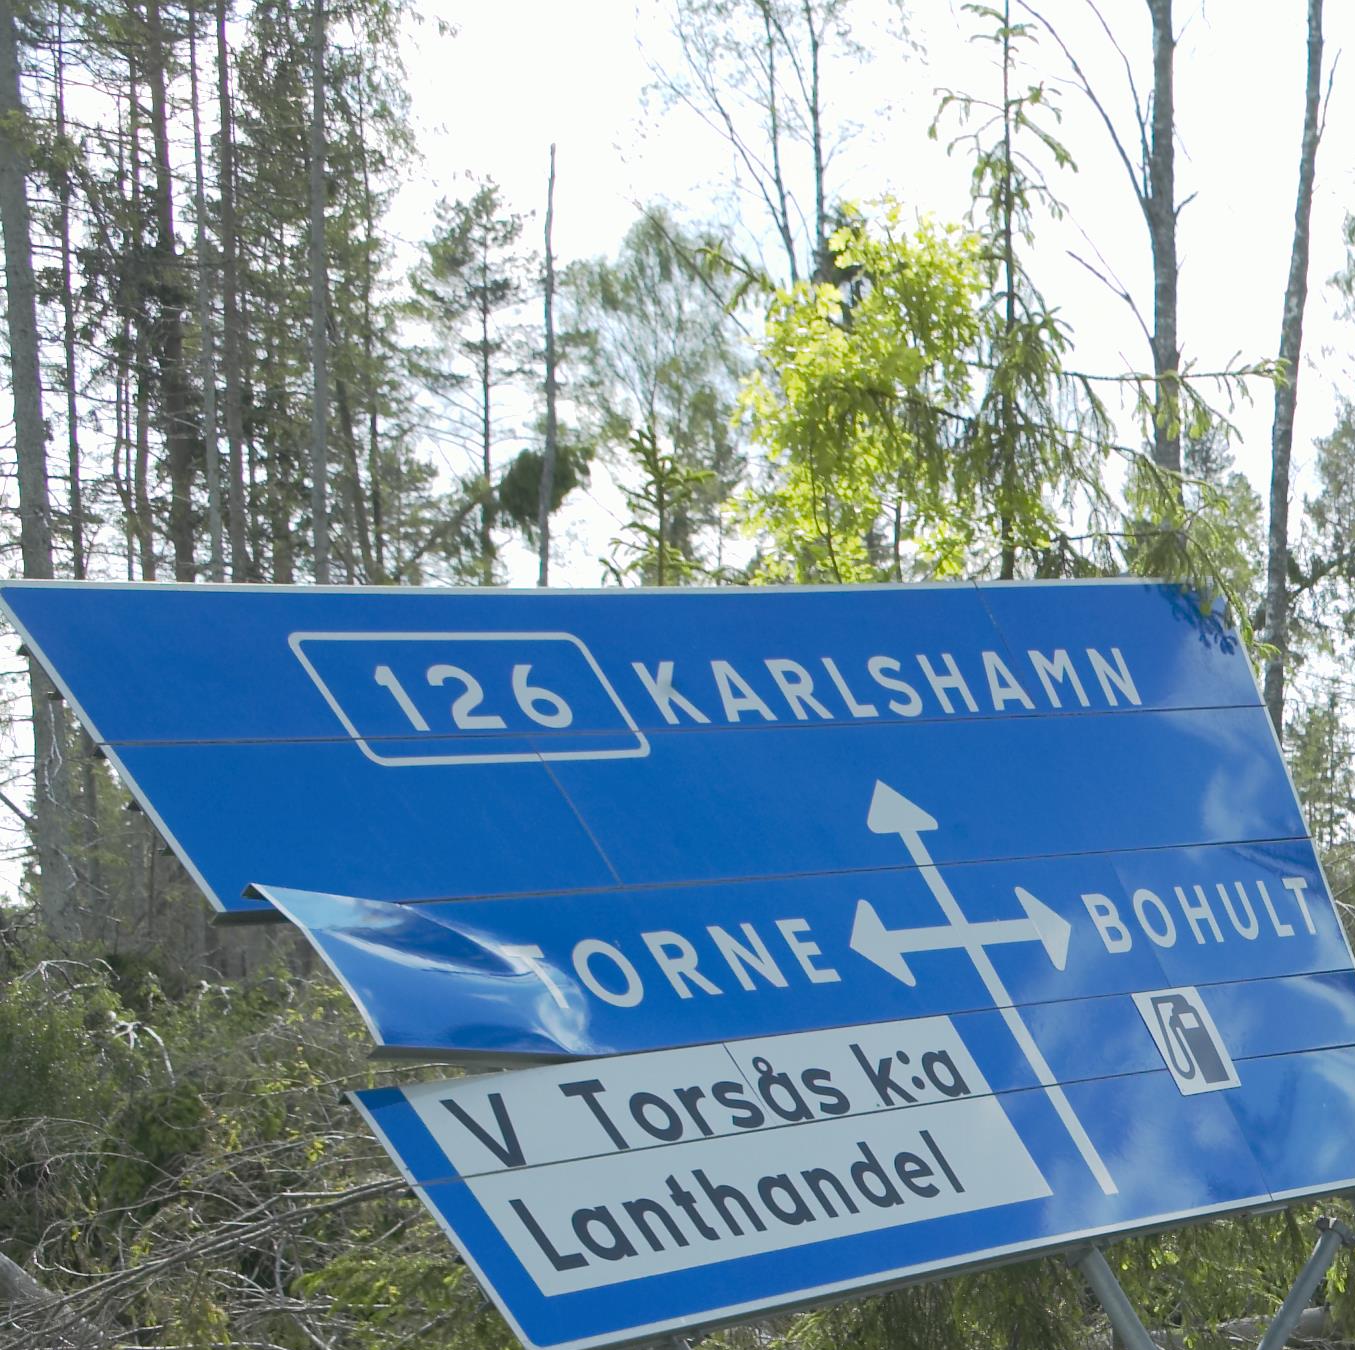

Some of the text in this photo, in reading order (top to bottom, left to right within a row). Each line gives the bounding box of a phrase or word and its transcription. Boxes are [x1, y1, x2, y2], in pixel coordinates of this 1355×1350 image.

[374, 647, 1143, 731] 126 KARLSHAMN
[1080, 876, 1317, 954] BOHULT
[500, 917, 842, 1009] TORNE
[439, 1043, 972, 1168] V Torsås k:a
[508, 1129, 966, 1272] Lanthandel
